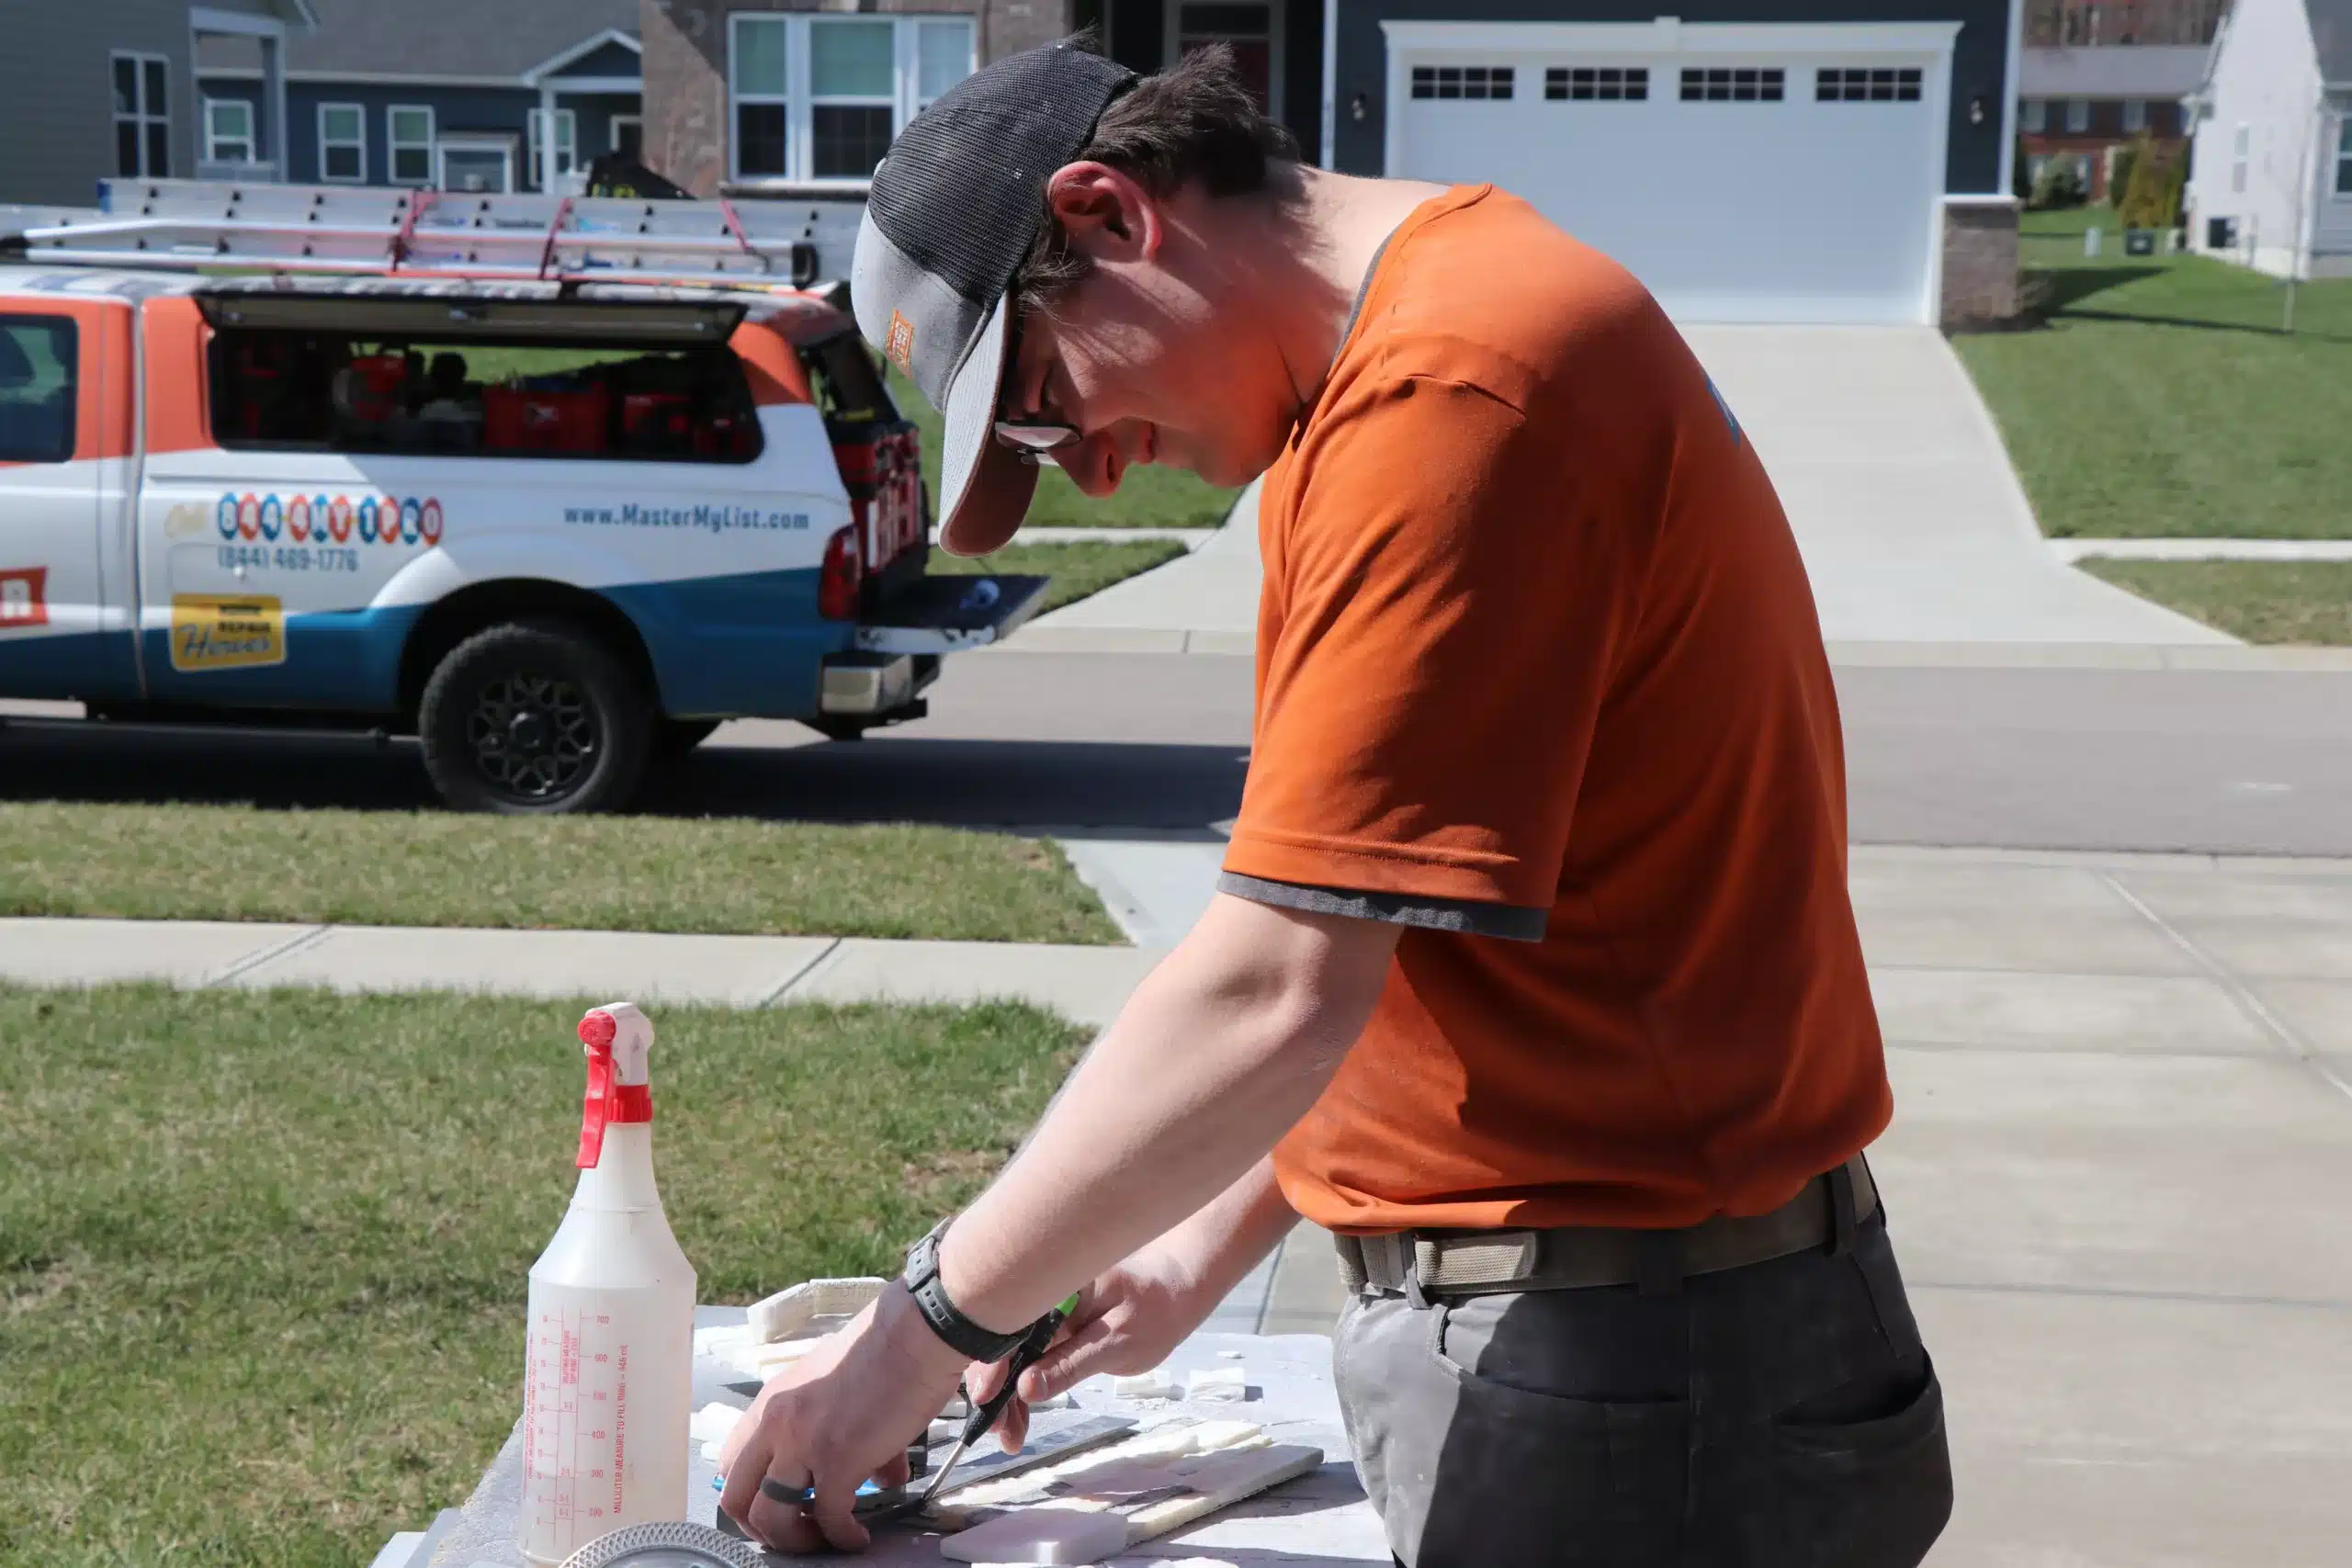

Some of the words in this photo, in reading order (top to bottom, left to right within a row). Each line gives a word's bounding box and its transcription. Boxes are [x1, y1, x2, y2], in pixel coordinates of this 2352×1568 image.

[564, 502, 809, 534] www.MasterMyList.com
[615, 1433, 625, 1470] MEASURE
[613, 1472, 622, 1514] MILLILITER
